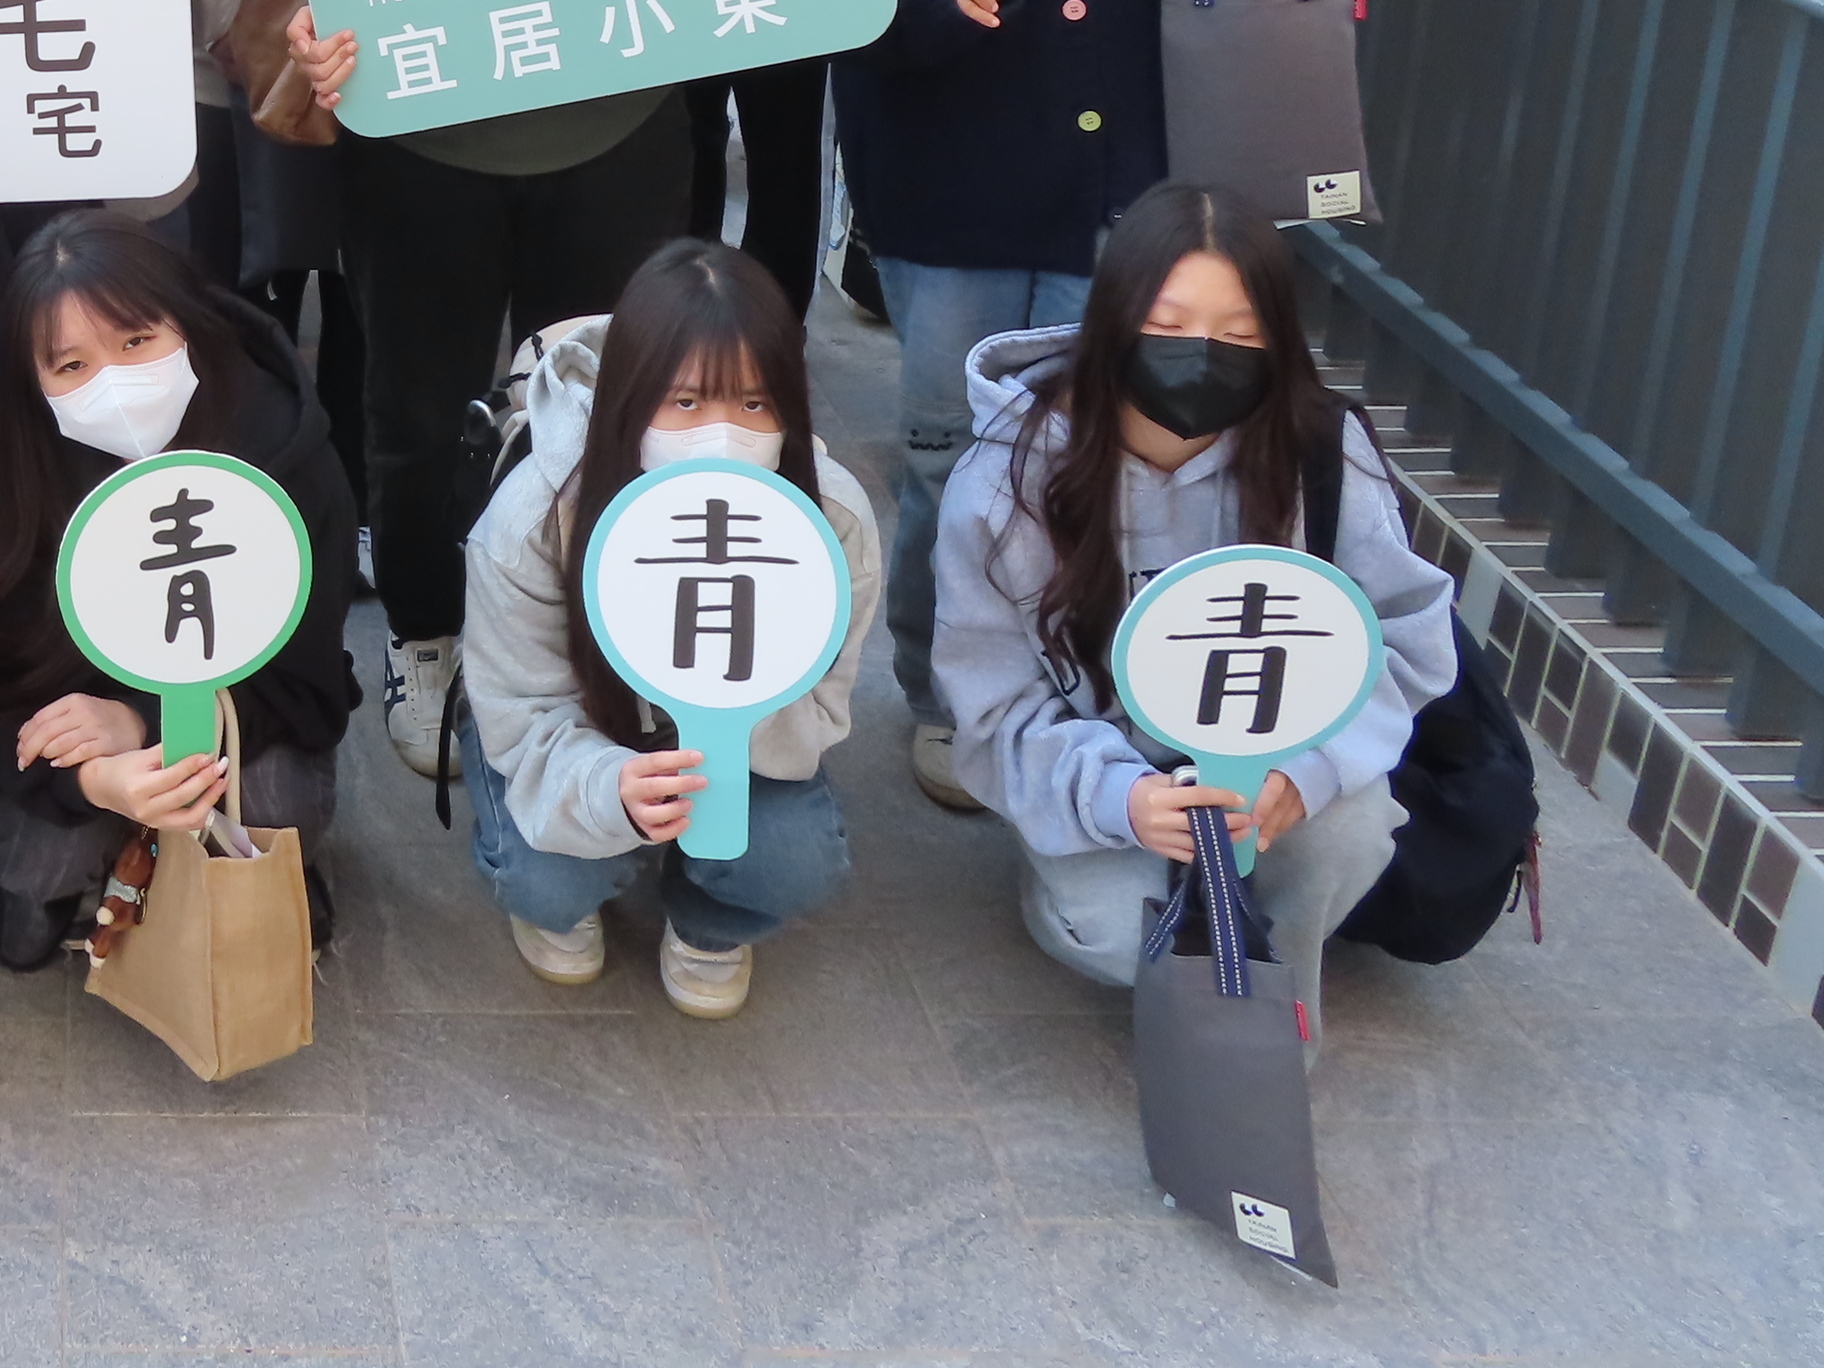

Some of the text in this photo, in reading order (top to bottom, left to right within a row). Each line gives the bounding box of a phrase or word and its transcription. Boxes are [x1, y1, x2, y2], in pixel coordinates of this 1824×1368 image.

[139, 487, 238, 661] 青
[634, 498, 800, 682] 青
[1165, 582, 1335, 734] 青
